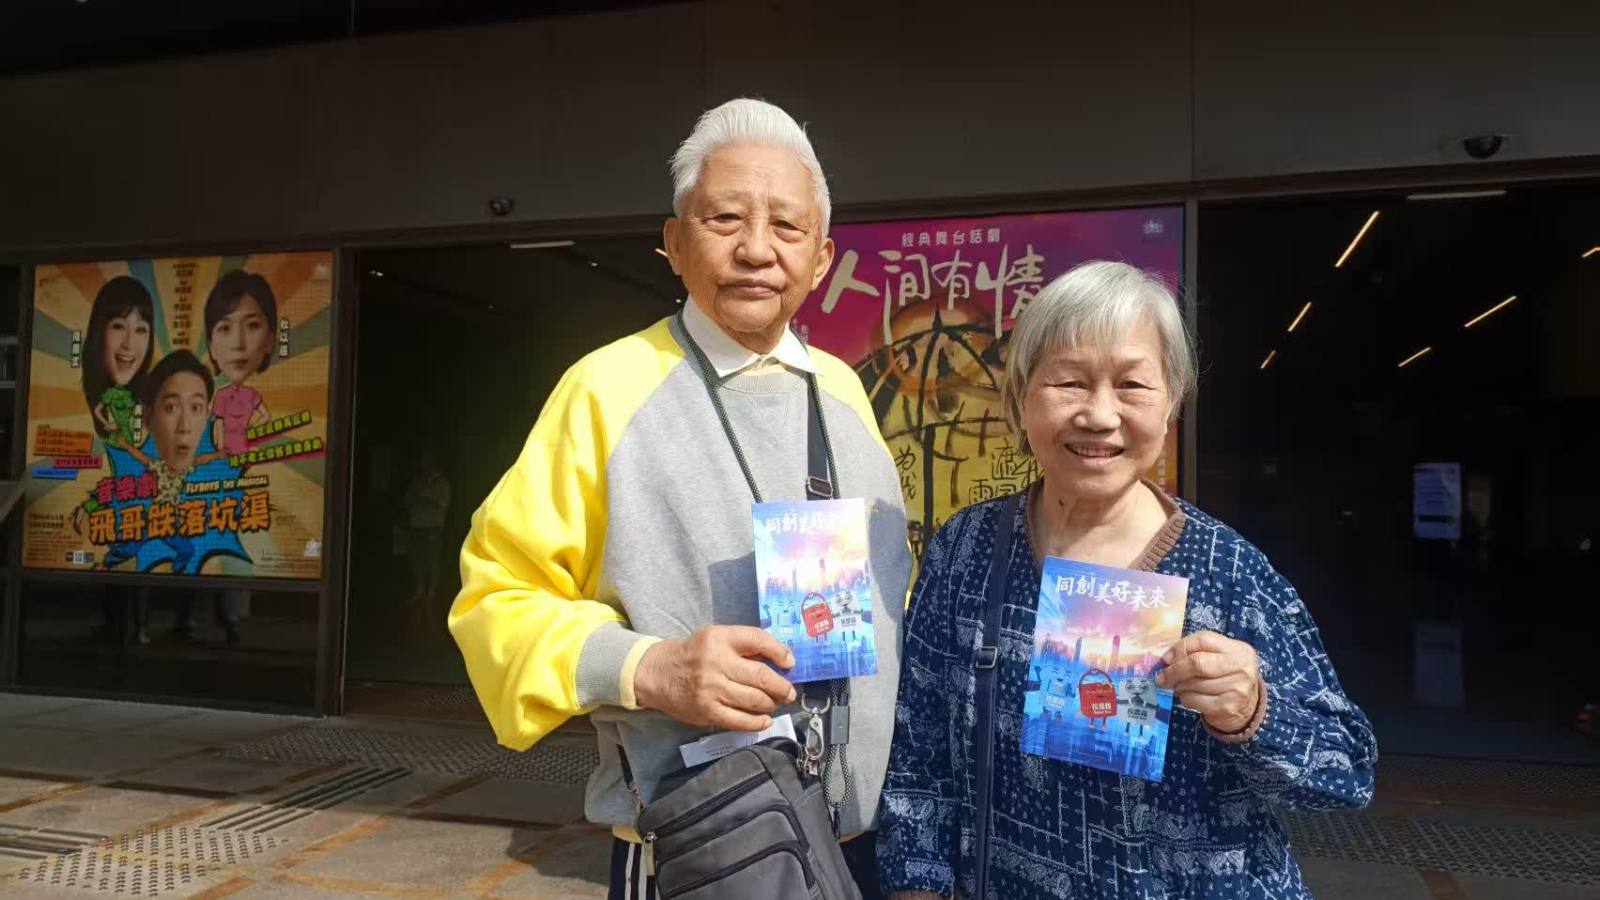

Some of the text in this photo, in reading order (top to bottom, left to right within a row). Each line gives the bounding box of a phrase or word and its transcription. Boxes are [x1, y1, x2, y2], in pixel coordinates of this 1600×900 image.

[902, 228, 1001, 247] 經典舞台話劇
[821, 243, 1047, 346] 人間有情
[96, 471, 159, 505] 音樂劇
[88, 491, 272, 545] 飛哥跌落坑渠
[1056, 574, 1169, 608] 同創美好未來
